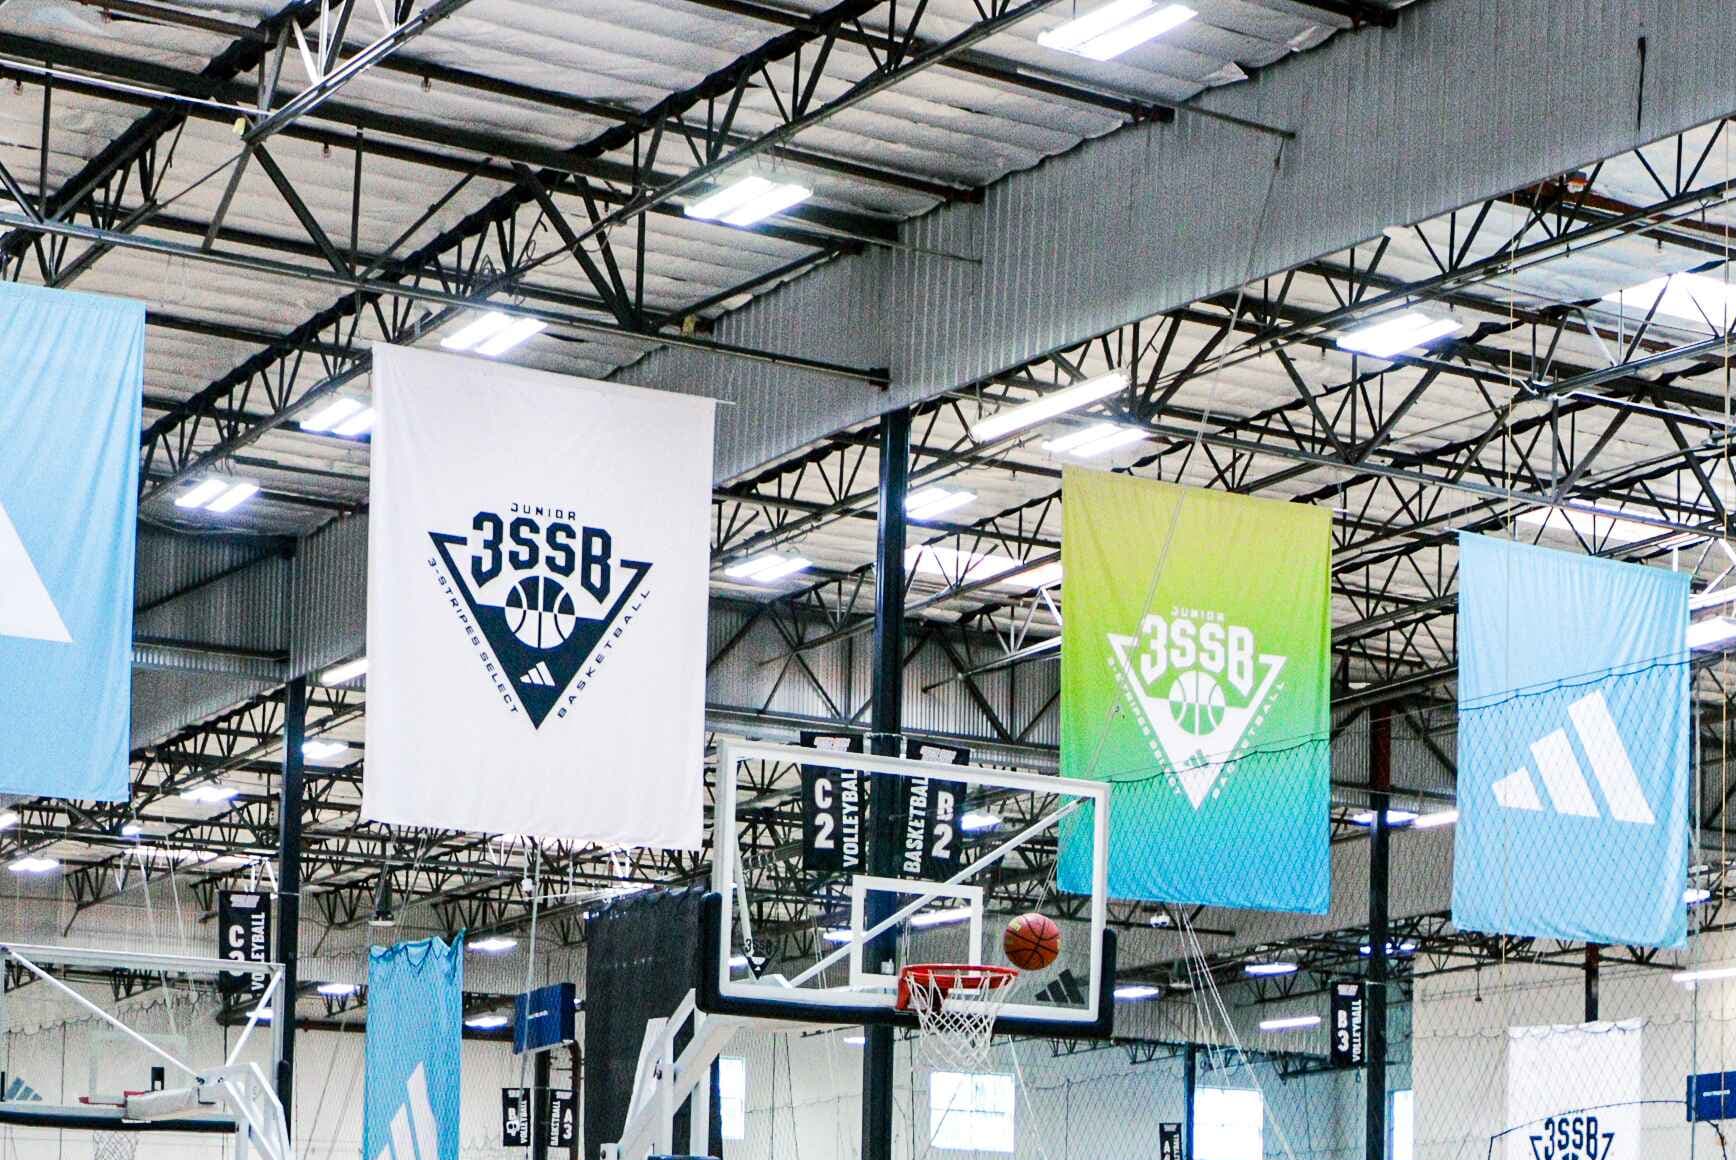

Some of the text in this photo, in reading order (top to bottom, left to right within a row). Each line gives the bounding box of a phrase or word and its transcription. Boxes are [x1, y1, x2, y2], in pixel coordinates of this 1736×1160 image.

[471, 511, 612, 605] 3SSB
[510, 503, 577, 521] JUNIOR
[427, 557, 520, 714] 3-STRIPES SELECT
[557, 589, 651, 719] BASKETBALL
[1140, 613, 1255, 698] 3SSB
[841, 767, 860, 868] VOLLEYBAL
[903, 776, 929, 873] BASKETBAL
[1352, 999, 1362, 1062] VOLLEYBALL
